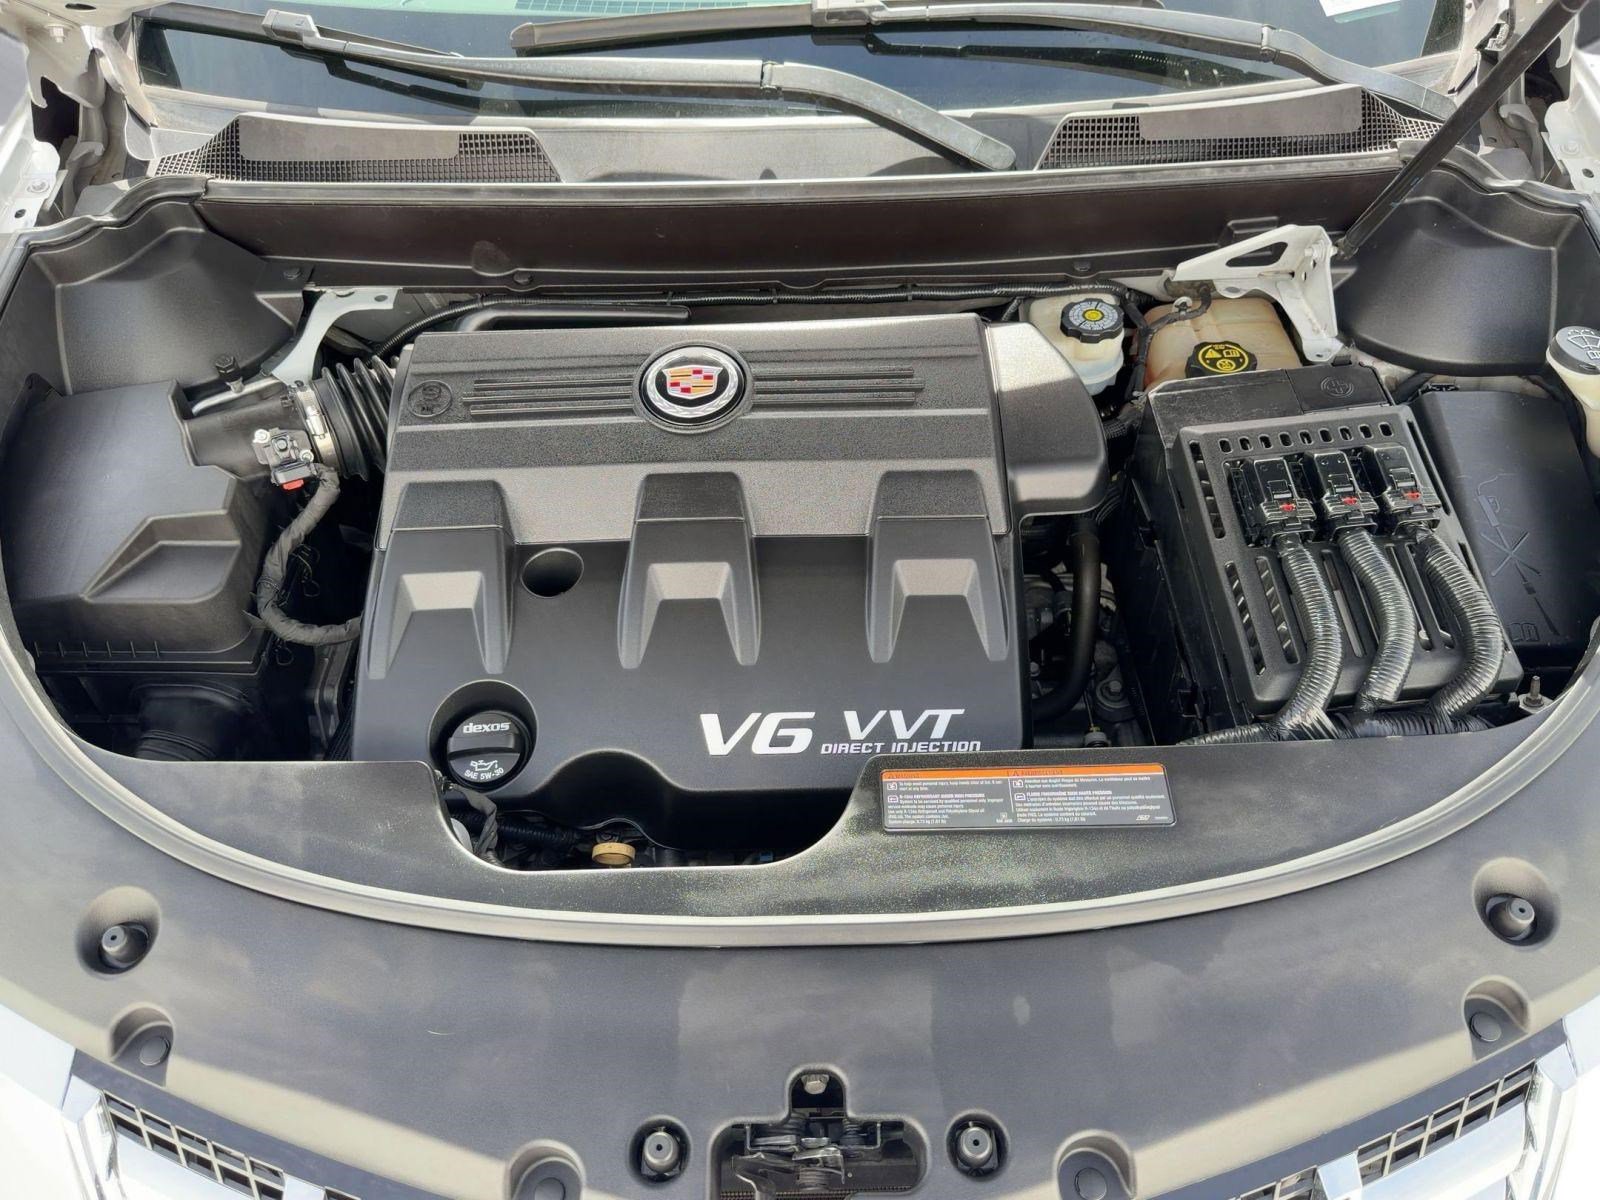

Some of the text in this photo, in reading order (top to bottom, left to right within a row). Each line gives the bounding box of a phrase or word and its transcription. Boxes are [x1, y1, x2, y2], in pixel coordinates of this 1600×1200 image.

[463, 722, 511, 734] dexos
[700, 709, 965, 755] V6 VVT
[820, 740, 981, 755] DIRECT INJECTION
[464, 767, 504, 780] SAE 5W-30
